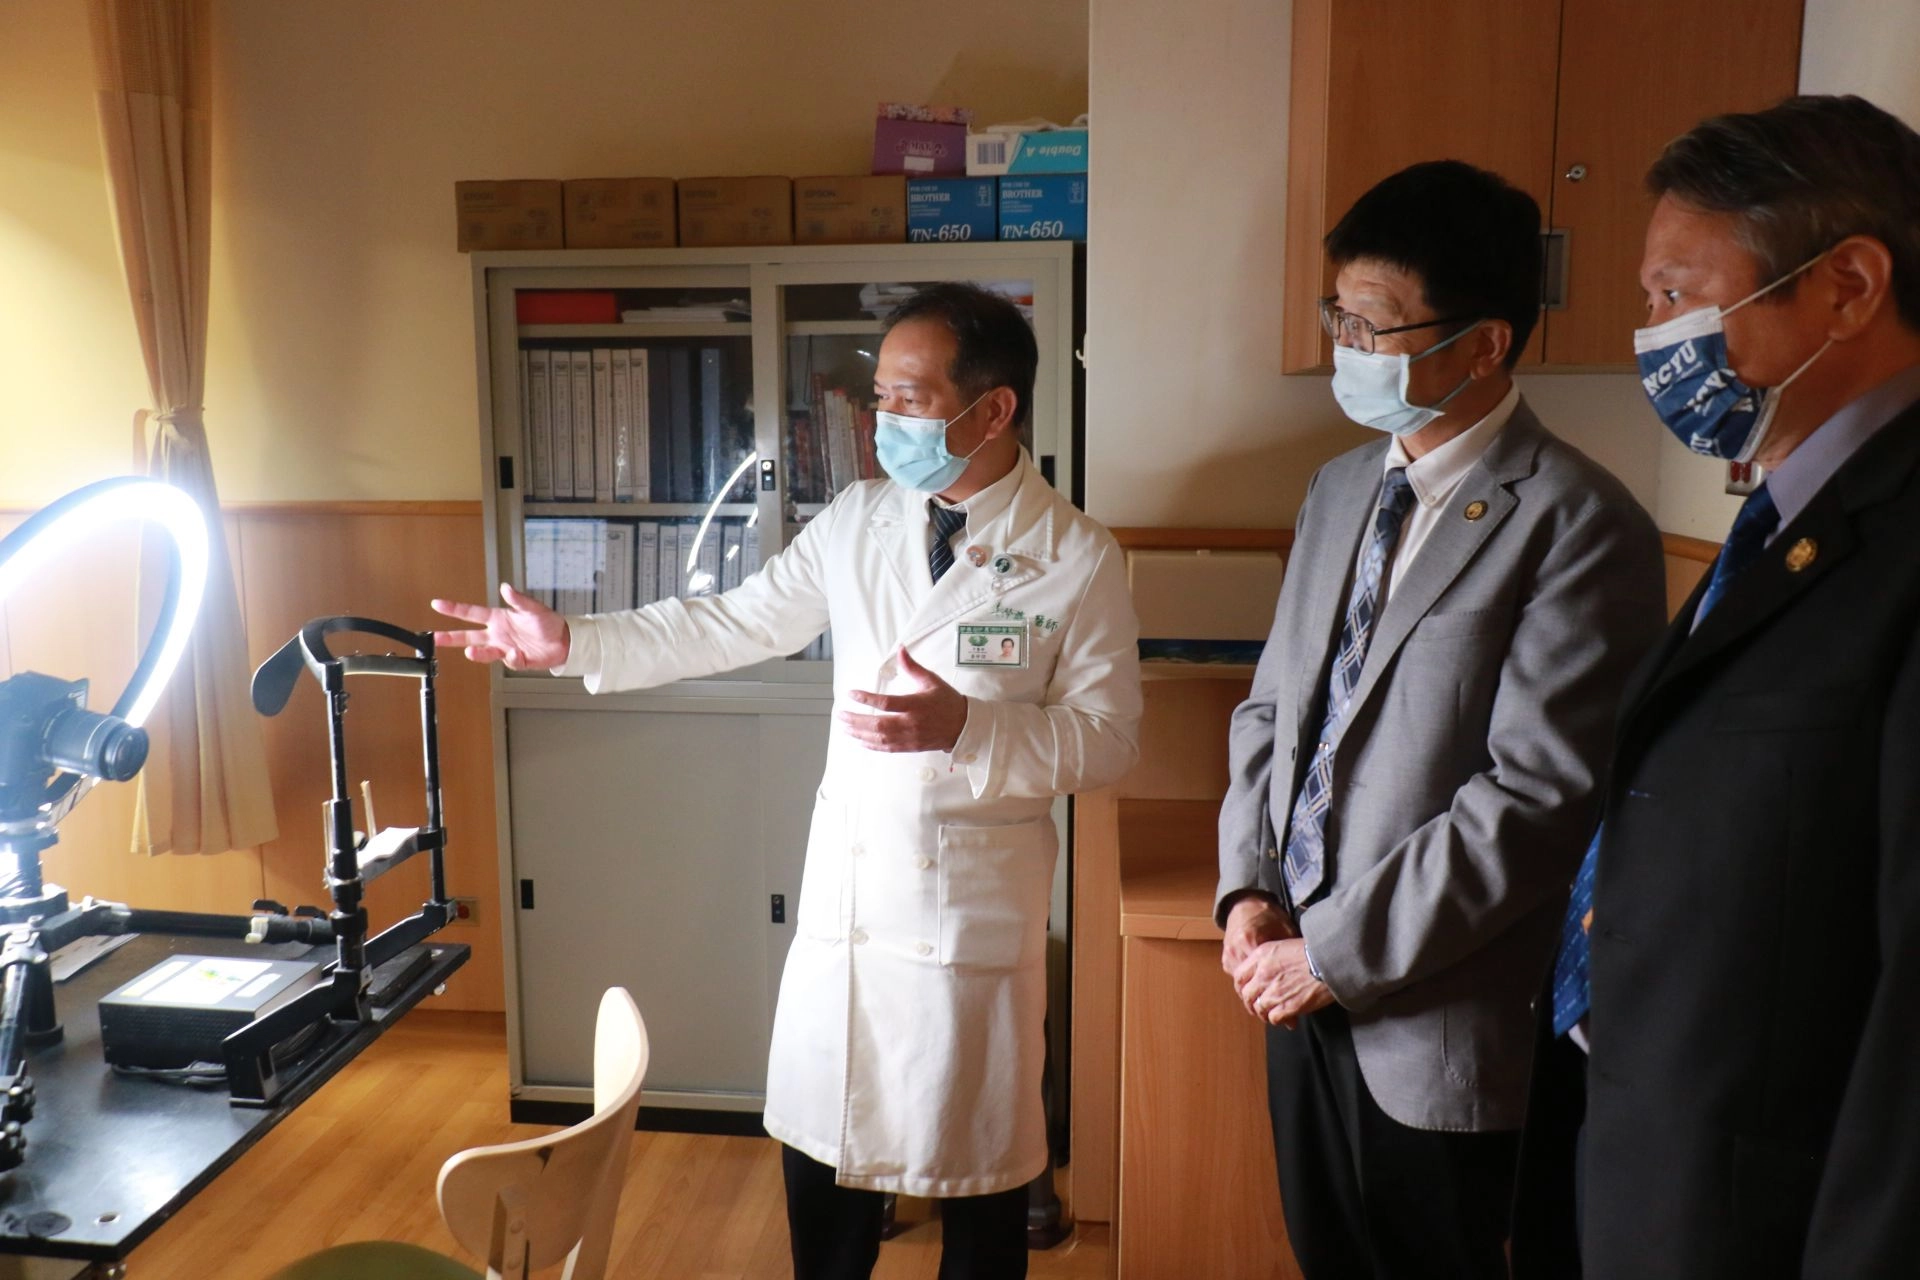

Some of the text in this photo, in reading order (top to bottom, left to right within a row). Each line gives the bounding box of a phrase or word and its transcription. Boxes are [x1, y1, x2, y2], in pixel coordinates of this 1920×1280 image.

[1026, 144, 1082, 158] Double A
[910, 192, 950, 203] BROTHER
[1002, 189, 1042, 199] BROTHER
[911, 223, 971, 242] TN-650
[1002, 220, 1063, 239] TN-650
[1642, 339, 1697, 396] NCYU
